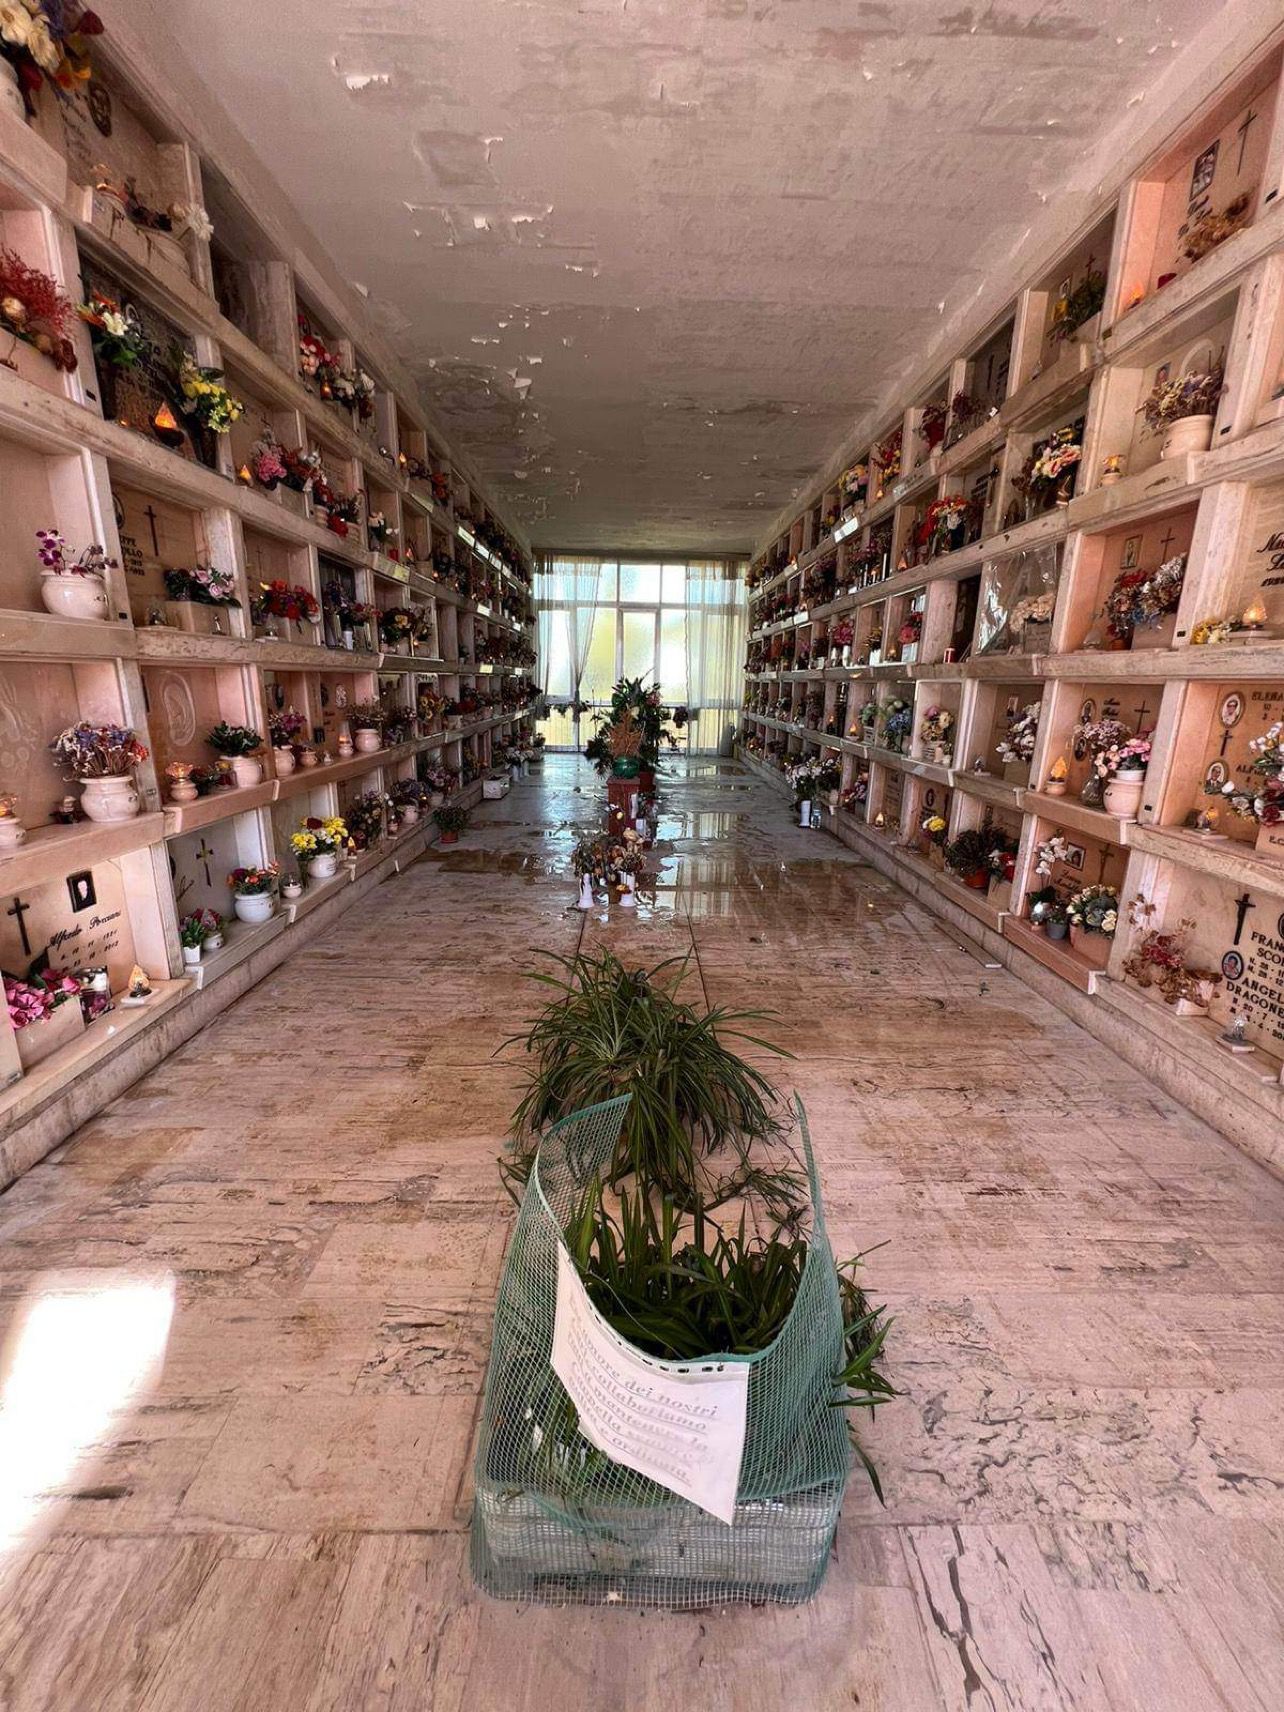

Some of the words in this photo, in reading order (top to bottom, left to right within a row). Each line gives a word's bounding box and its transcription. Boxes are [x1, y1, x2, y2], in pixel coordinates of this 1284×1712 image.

[1251, 931, 1284, 953] FRAN
[625, 1380, 653, 1398] dei
[659, 1394, 718, 1416] nostri
